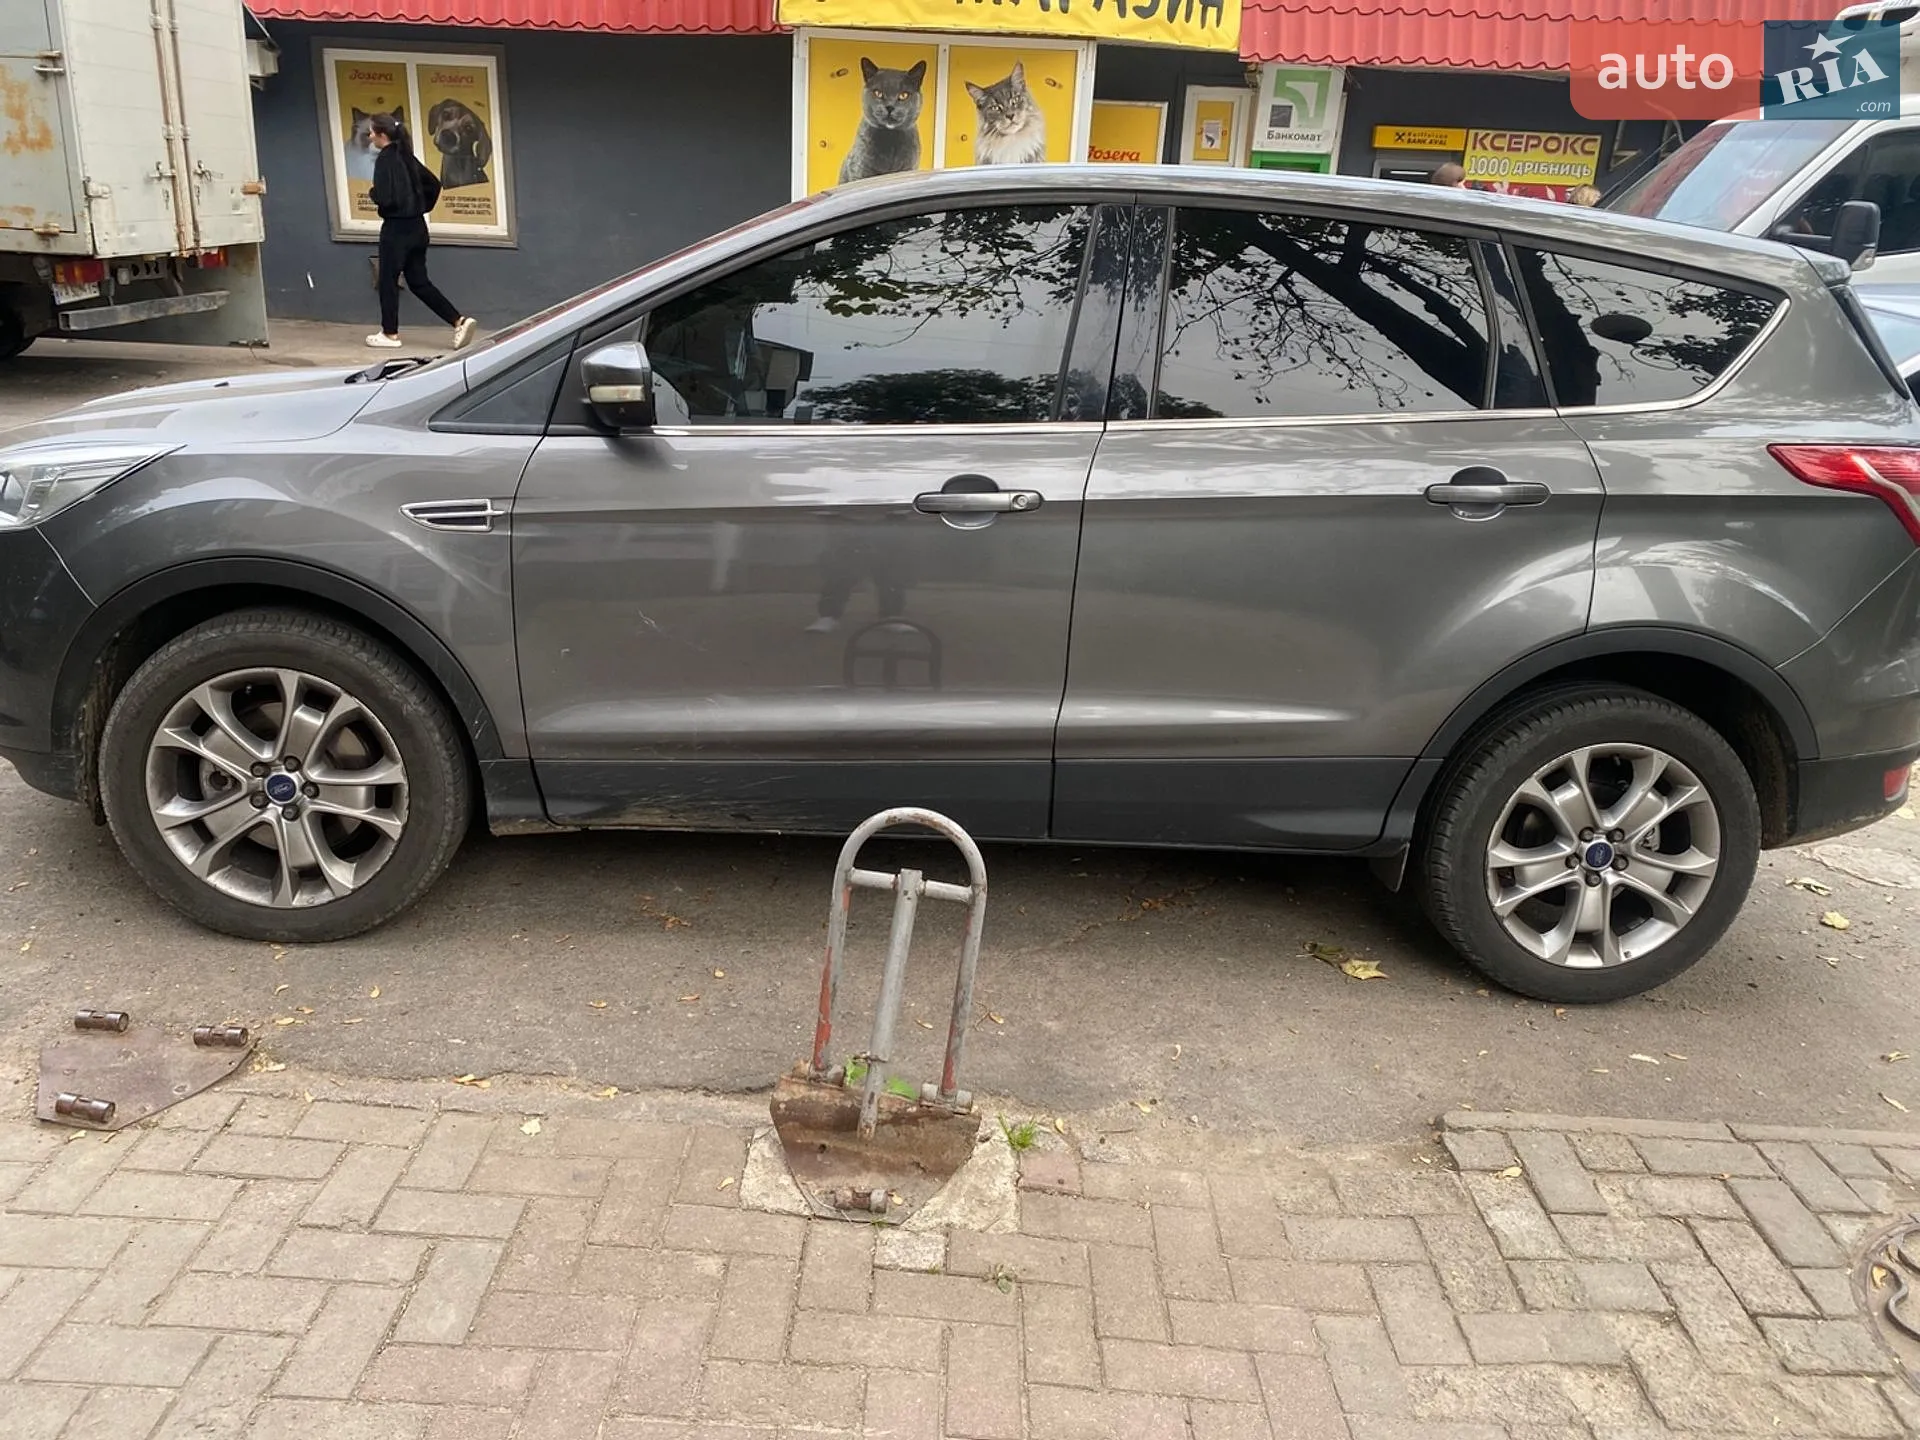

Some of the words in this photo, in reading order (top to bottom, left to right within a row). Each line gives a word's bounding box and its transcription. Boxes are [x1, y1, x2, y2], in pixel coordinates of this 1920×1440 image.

[349, 69, 393, 81] Josera
[430, 72, 474, 84] Josera
[1267, 130, 1322, 142] Банкомат
[1472, 131, 1598, 156] КСЕРОКС
[1468, 156, 1511, 176] 1000
[1513, 160, 1592, 177] ДРІБНИЦЬ
